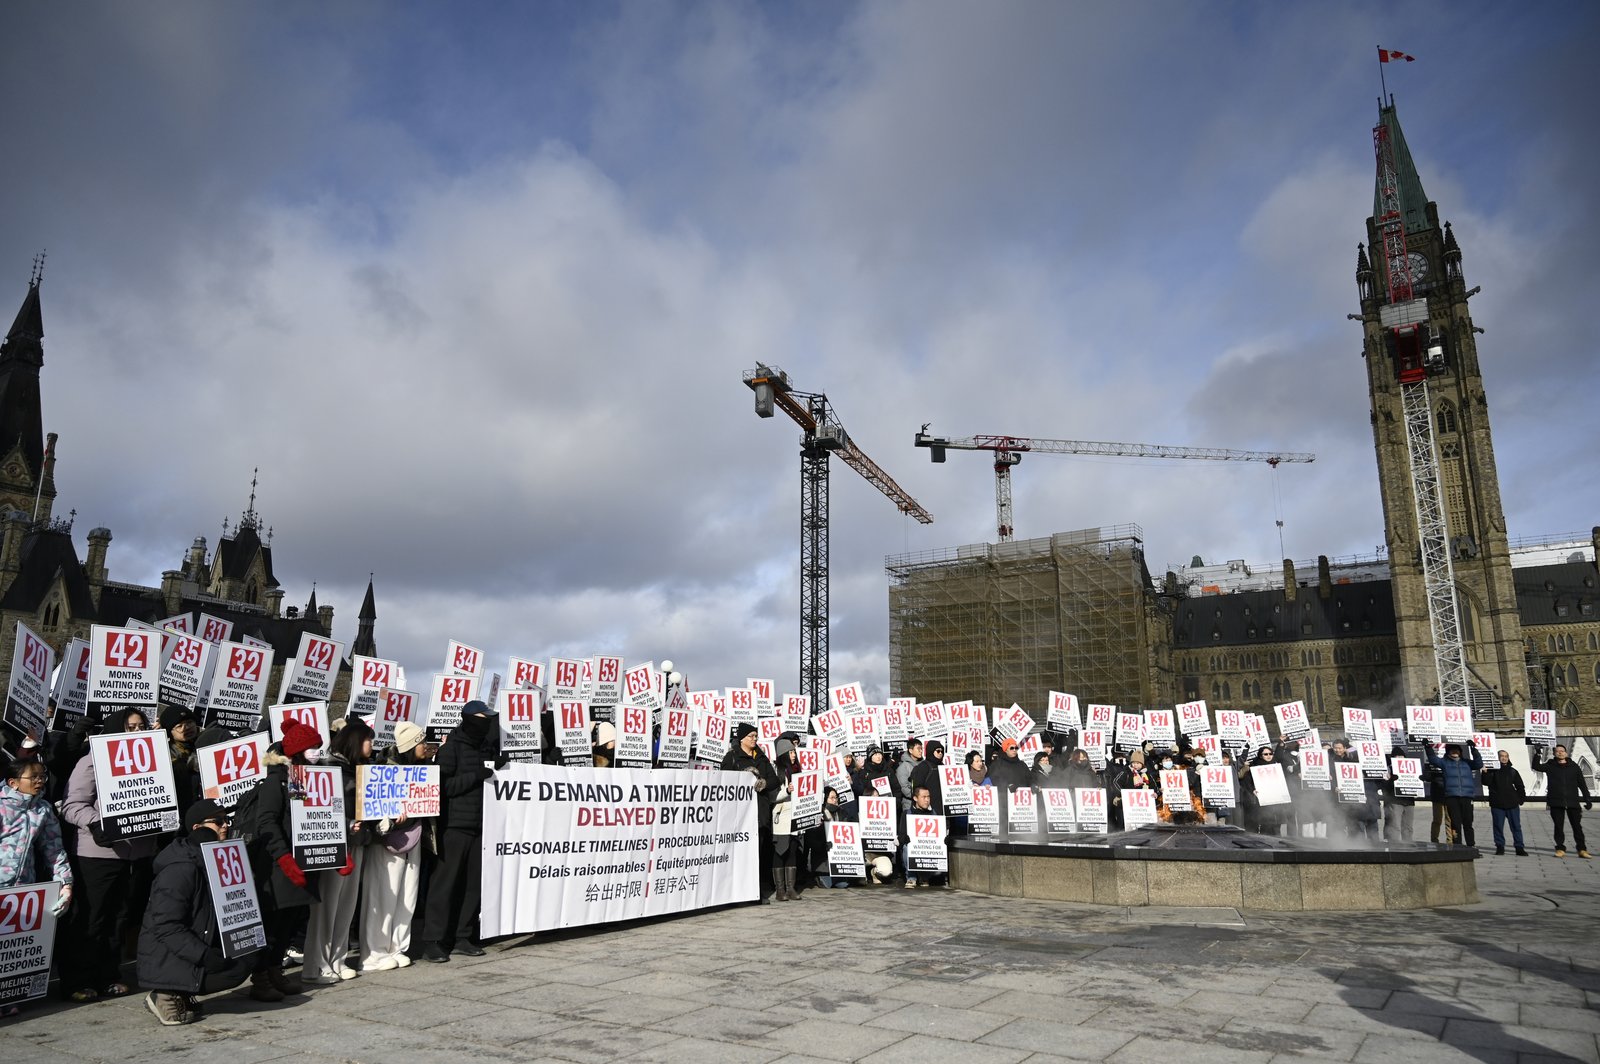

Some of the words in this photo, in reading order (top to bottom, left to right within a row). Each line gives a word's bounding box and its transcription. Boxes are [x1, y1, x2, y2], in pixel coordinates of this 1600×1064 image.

[206, 621, 224, 643] 31
[110, 634, 143, 667] 42
[175, 637, 199, 665] 35
[308, 640, 332, 670] 42
[25, 639, 45, 678] 20
[232, 649, 260, 681] 32
[456, 647, 474, 672] 34
[109, 670, 142, 679] MONTHS
[165, 669, 186, 681] WAITING
[188, 675, 198, 684] FOR
[171, 663, 194, 675] MONTHS
[304, 670, 326, 680] MONTHS
[365, 662, 387, 687] 22
[518, 663, 536, 686] 31
[560, 662, 573, 686] 15
[601, 659, 617, 682] 53
[100, 680, 133, 690] WAITING
[135, 681, 150, 690] FOR
[170, 678, 199, 692] RESPONSE
[228, 681, 253, 692] MONTHS
[297, 677, 318, 686] WAITING
[629, 669, 649, 694] 68
[94, 690, 111, 698] IRCC
[113, 691, 153, 700] RESPONSE
[220, 689, 245, 700] WAITING
[246, 692, 258, 700] FOR
[303, 686, 329, 698] RESPONSE
[444, 679, 465, 702] 31
[839, 688, 856, 704] 43
[213, 698, 228, 707] IRCC
[228, 699, 259, 710] RESPONSE
[512, 695, 530, 720] 11
[734, 692, 750, 708] 33
[790, 698, 804, 715] 38
[1057, 696, 1070, 709] 70
[388, 694, 406, 722] 31
[564, 703, 581, 728] 71
[926, 706, 940, 721] 63
[953, 705, 967, 720] 27
[1095, 708, 1108, 720] 36
[1184, 705, 1200, 718] 90
[1283, 705, 1299, 719] 38
[1351, 711, 1365, 720] 32
[1415, 709, 1431, 721] 20
[1447, 709, 1463, 721] 31
[627, 708, 644, 734] 53
[670, 712, 686, 736] 34
[822, 711, 840, 732] 30
[886, 709, 901, 724] 65
[1123, 717, 1137, 730] 28
[1151, 714, 1166, 726] 37
[1224, 714, 1238, 725] 39
[1532, 712, 1548, 724] 30
[708, 717, 724, 739] 68
[763, 720, 779, 738] 34
[854, 718, 872, 734] 55
[954, 732, 966, 748] 72
[1023, 737, 1035, 752] 11
[1086, 733, 1100, 746] 31
[1476, 736, 1490, 747] 37
[114, 738, 151, 774] 40
[1364, 744, 1379, 756] 38
[221, 744, 255, 781] 42
[802, 751, 817, 770] 33
[1307, 752, 1322, 766] 37
[370, 766, 398, 782] STOP
[403, 767, 427, 782] THE
[1342, 765, 1356, 778] 37
[1400, 761, 1415, 773] 40
[118, 777, 154, 789] MONTHS
[948, 769, 963, 784] 34
[1168, 774, 1182, 787] 37
[1210, 770, 1225, 783] 37
[110, 787, 147, 801] WAITING
[149, 785, 165, 795] FOR
[223, 778, 257, 794] MONTHS
[307, 772, 330, 806] 40
[493, 780, 532, 800] WE
[538, 781, 623, 802] DEMAND
[629, 785, 641, 802] A
[644, 784, 698, 802] TIMELY
[701, 785, 755, 801] DECISION
[800, 775, 816, 797] 41
[106, 802, 126, 813] IRCC
[127, 795, 171, 809] RESPONSE
[975, 790, 990, 804] 35
[1016, 790, 1031, 805] 18
[1050, 792, 1066, 806] 36
[1084, 792, 1100, 806] 21
[1132, 792, 1147, 806] 14
[307, 811, 332, 819] MONTHS
[577, 807, 656, 827] DELAYED
[660, 807, 680, 824] BY
[683, 806, 714, 824] IRCC
[869, 800, 887, 818] 40
[117, 817, 128, 826] NO
[121, 826, 132, 834] NO
[133, 820, 162, 832] RESULTS
[301, 822, 326, 831] WAITING
[327, 821, 338, 830] FOR
[918, 819, 936, 837] 22
[298, 832, 312, 842] IRCC
[312, 832, 342, 840] RESPONSE
[836, 826, 852, 843] 43
[312, 847, 338, 855] TIMELINES
[496, 841, 586, 856] REASONABLE
[589, 839, 648, 852] TIMELINES
[658, 835, 714, 849] PROCEDURAL
[715, 832, 750, 845] FAIRNESS
[217, 846, 242, 886] 36
[315, 855, 336, 863] RESULTS
[529, 864, 571, 879] Délais
[574, 860, 646, 877] raisonnables
[656, 855, 684, 870] Équité
[685, 853, 729, 868] procédurale
[585, 880, 642, 902] 给出时限
[654, 874, 699, 895] 程序公平
[244, 899, 254, 908] FOR
[0, 891, 39, 933] 20
[24, 946, 42, 957] FOR
